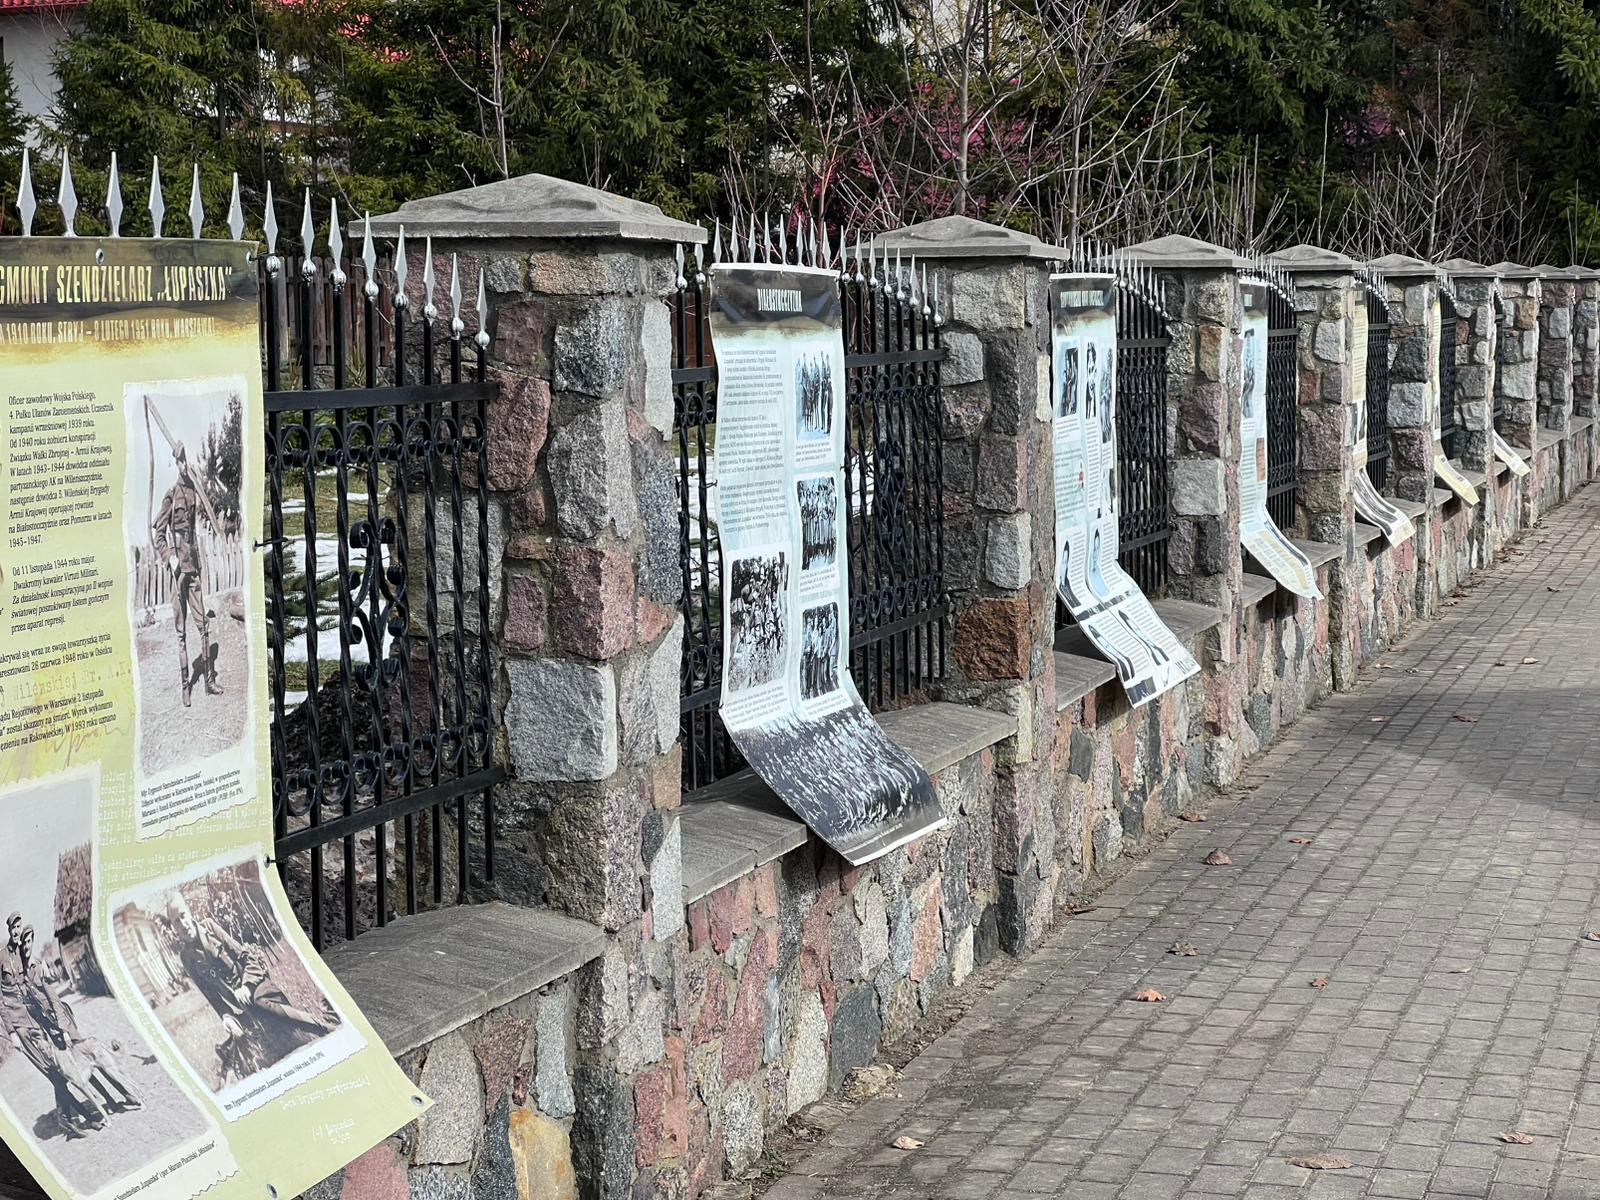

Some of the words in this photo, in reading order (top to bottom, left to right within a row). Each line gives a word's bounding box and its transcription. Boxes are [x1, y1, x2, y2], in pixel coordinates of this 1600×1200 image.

[56, 265, 153, 304] SZENDZIELARZ
[26, 394, 52, 405] zawodowy
[53, 392, 72, 404] Wojska
[68, 419, 82, 430] 1939
[18, 437, 34, 448] 1940
